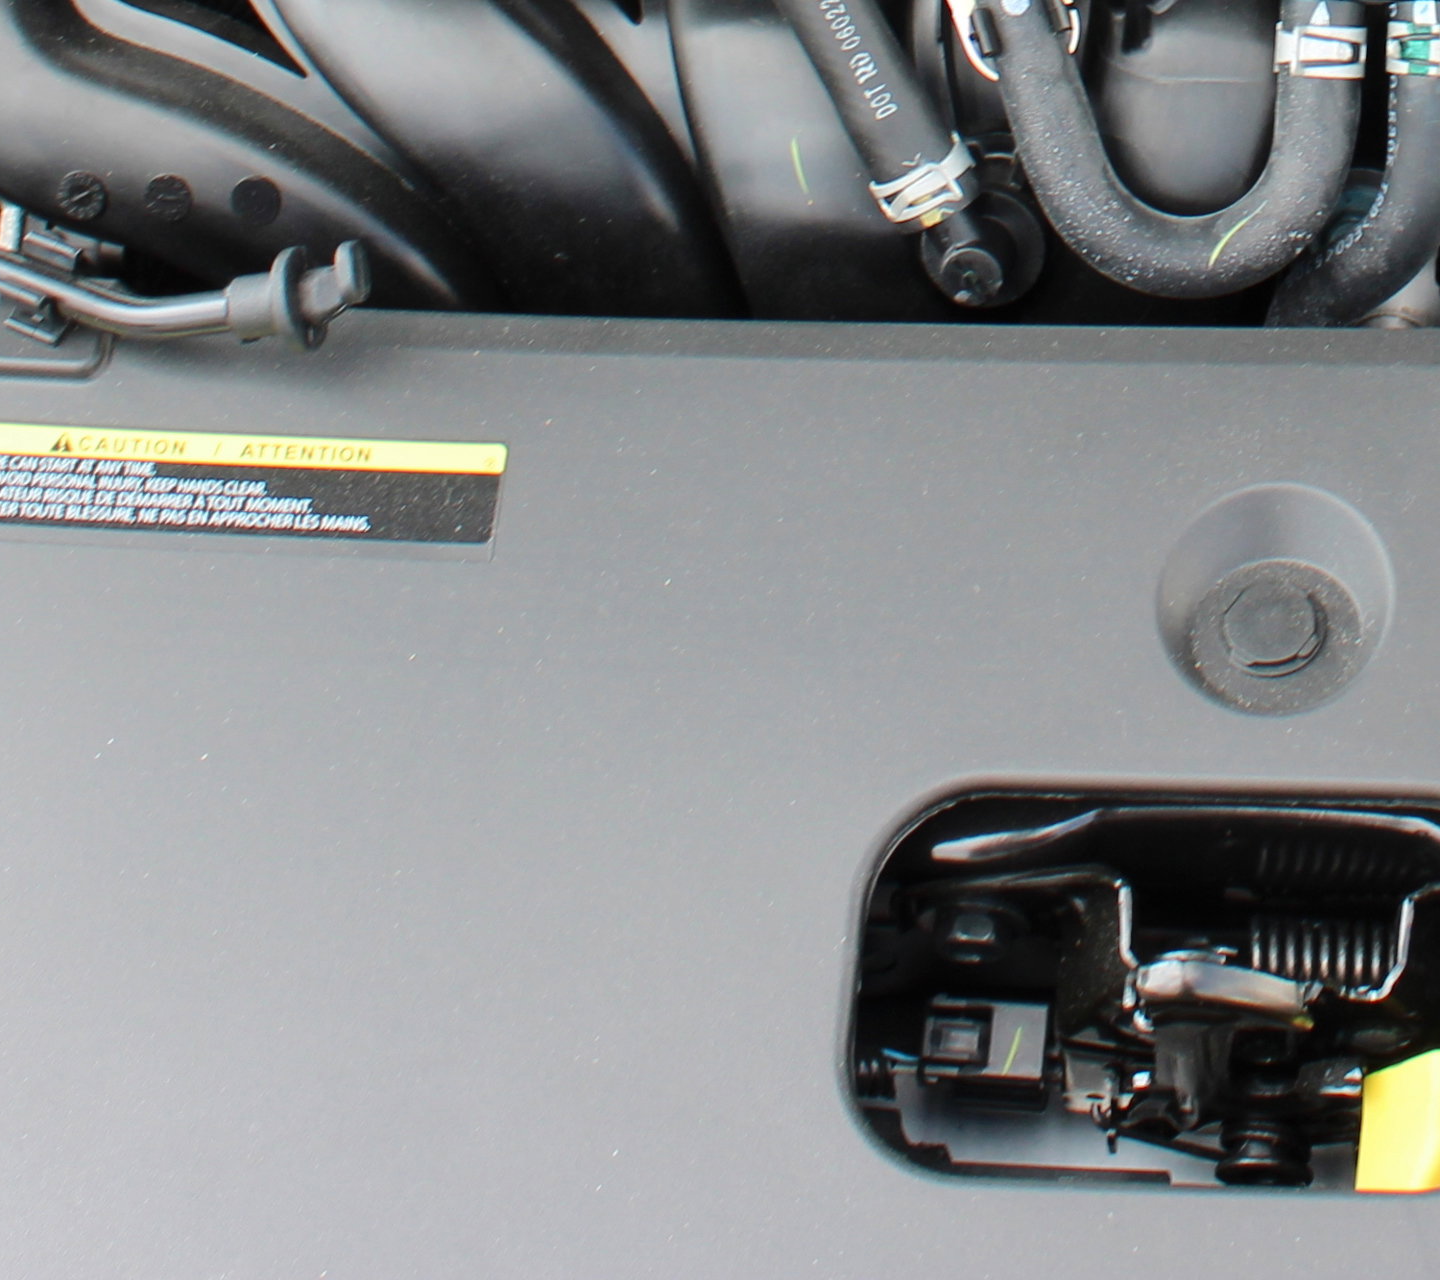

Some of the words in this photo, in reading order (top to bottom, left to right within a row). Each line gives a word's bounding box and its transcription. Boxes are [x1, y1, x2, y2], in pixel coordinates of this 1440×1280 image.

[864, 83, 898, 120] DOT
[78, 435, 188, 456] CAUTION
[240, 444, 373, 463] ATTENTION
[10, 455, 39, 471] CAN
[38, 456, 79, 473] START
[77, 458, 96, 473] AT
[95, 459, 123, 475] ANY
[30, 471, 97, 489] PERSONAL
[144, 476, 178, 492] KEEP
[177, 478, 224, 494] HANDS
[42, 487, 96, 505] RISQUE
[94, 490, 117, 505] DE
[207, 495, 247, 512] TOUT
[19, 502, 66, 519] TOUTE
[138, 508, 160, 523] NE
[160, 509, 188, 524] PAS
[187, 510, 209, 526] EN
[208, 511, 295, 529] APPROCHER
[294, 514, 320, 531] LES
